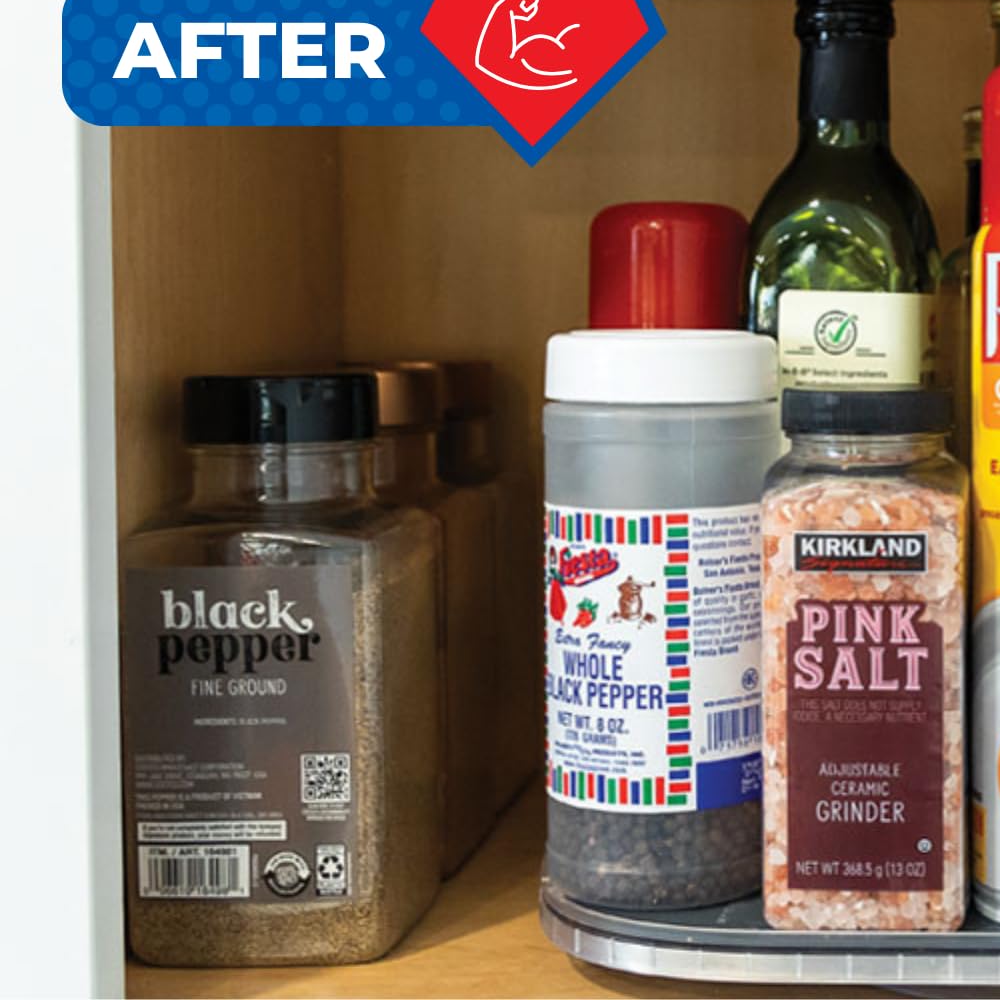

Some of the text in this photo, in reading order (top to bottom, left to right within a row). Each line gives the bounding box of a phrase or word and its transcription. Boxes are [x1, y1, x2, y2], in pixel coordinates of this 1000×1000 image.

[801, 537, 922, 557] KIRKLAND
[160, 588, 314, 634] black
[801, 604, 921, 644] PINK
[156, 632, 322, 675] pepper
[587, 632, 632, 654] Fancy
[563, 650, 624, 682] WHOLE
[793, 645, 929, 691] SALT
[191, 679, 288, 696] FINE GROUND
[586, 682, 664, 710] PEPPER
[597, 717, 604, 733] 8
[607, 718, 630, 734] OZ.
[819, 762, 902, 777] ADJUSTABLE
[831, 781, 890, 796] CERAMIC
[815, 800, 906, 823] GRINDER
[796, 860, 819, 875] NET
[821, 861, 841, 875] WT
